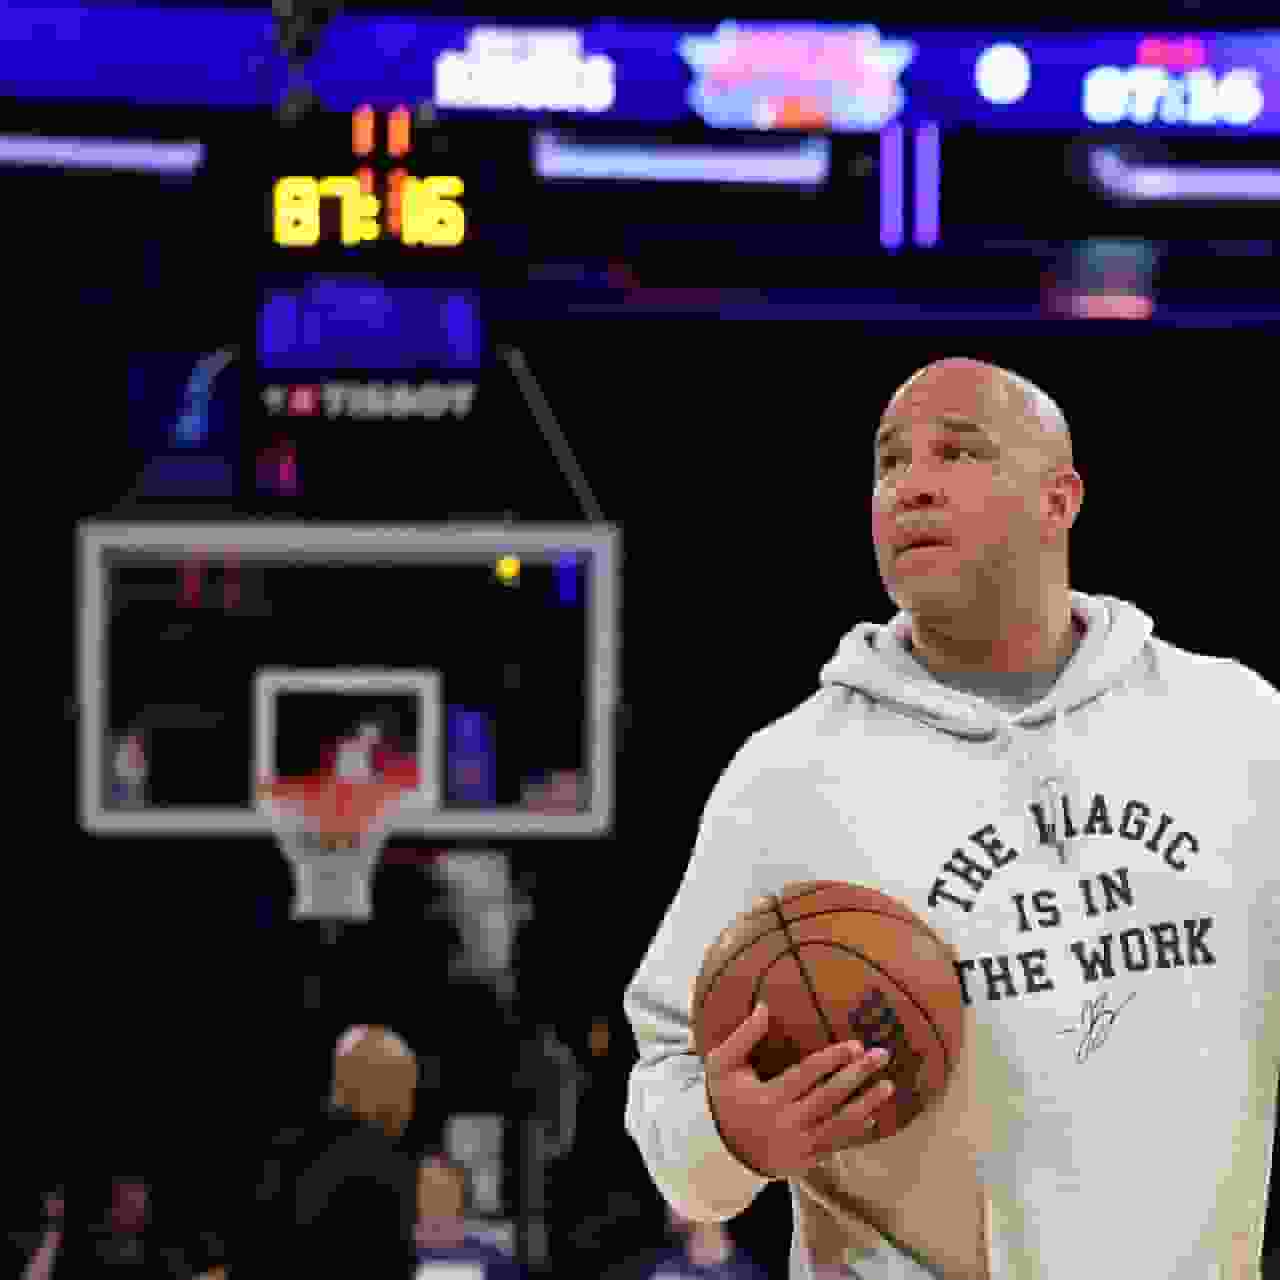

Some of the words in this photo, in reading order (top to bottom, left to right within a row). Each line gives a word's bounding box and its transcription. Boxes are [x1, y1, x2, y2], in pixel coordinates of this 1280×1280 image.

[928, 823, 1019, 913] THE
[1011, 889, 1062, 933] IS
[1077, 866, 1136, 918] IN
[1069, 916, 1218, 984] WORK
